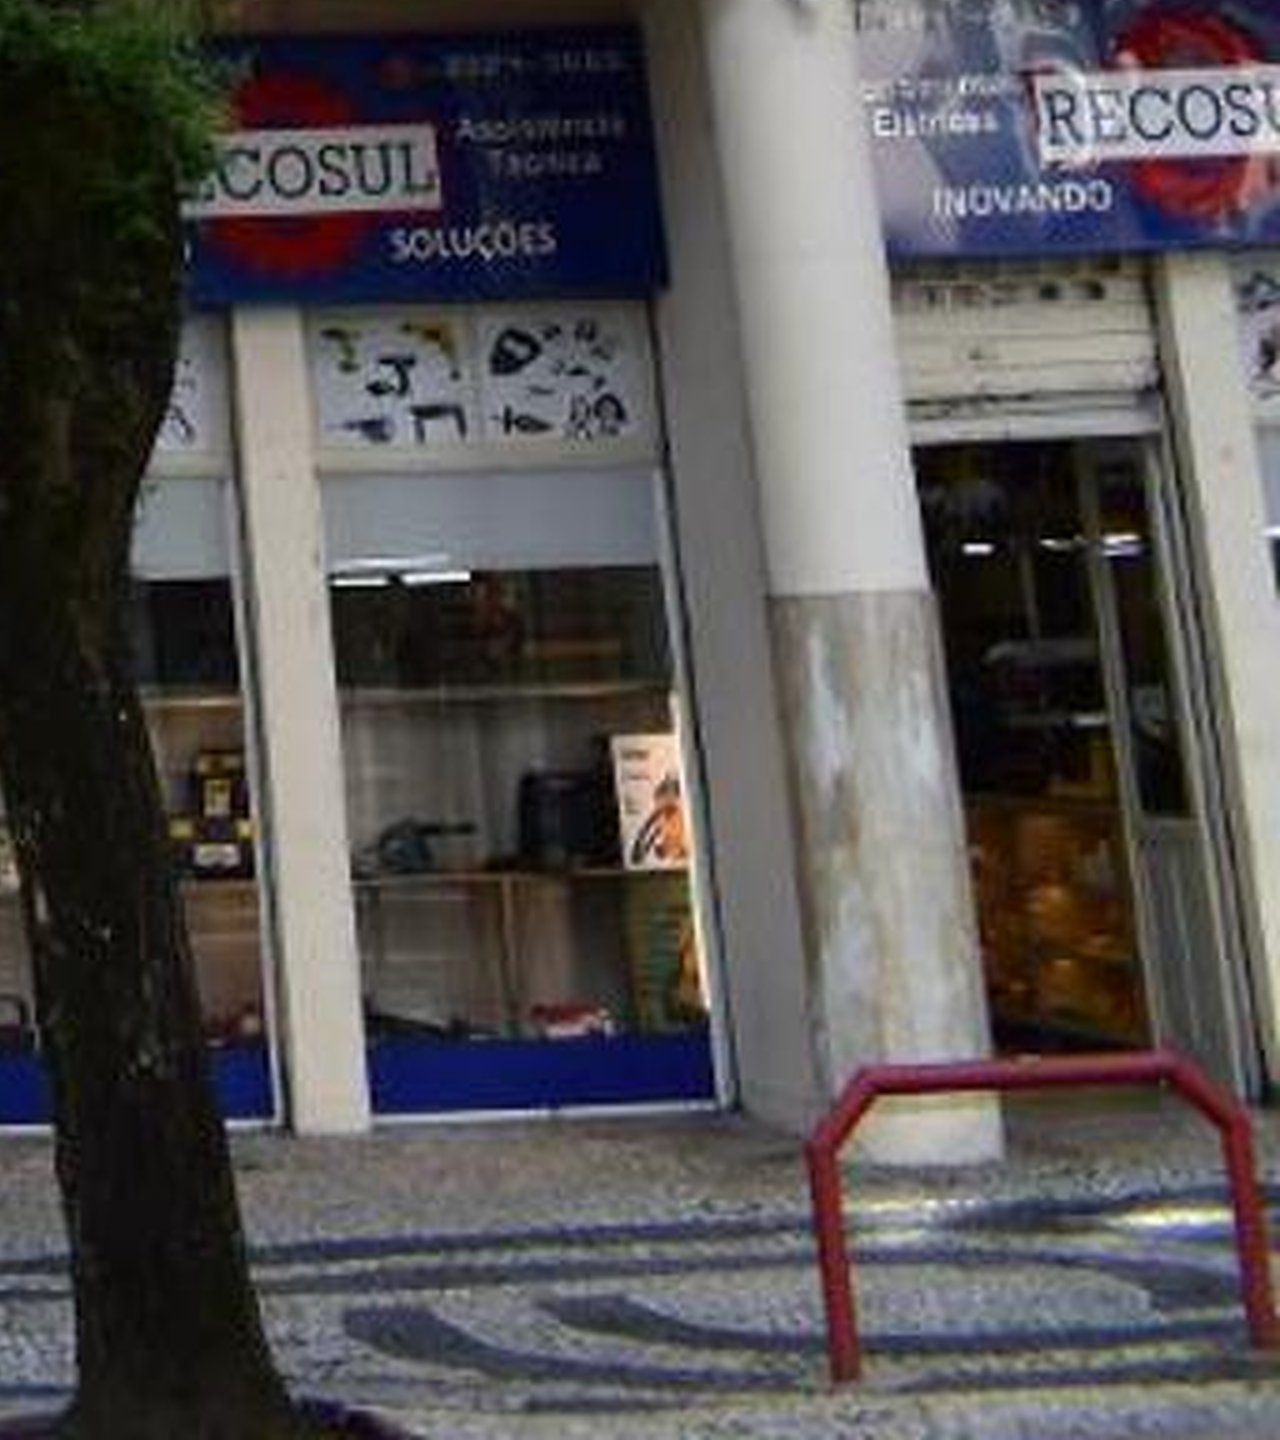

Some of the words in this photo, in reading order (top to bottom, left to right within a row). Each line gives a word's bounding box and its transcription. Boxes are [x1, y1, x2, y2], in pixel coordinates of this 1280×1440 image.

[178, 141, 437, 201] COSUL
[933, 181, 1113, 217] INOVANDO
[388, 221, 558, 262] SOLUÇÕES
